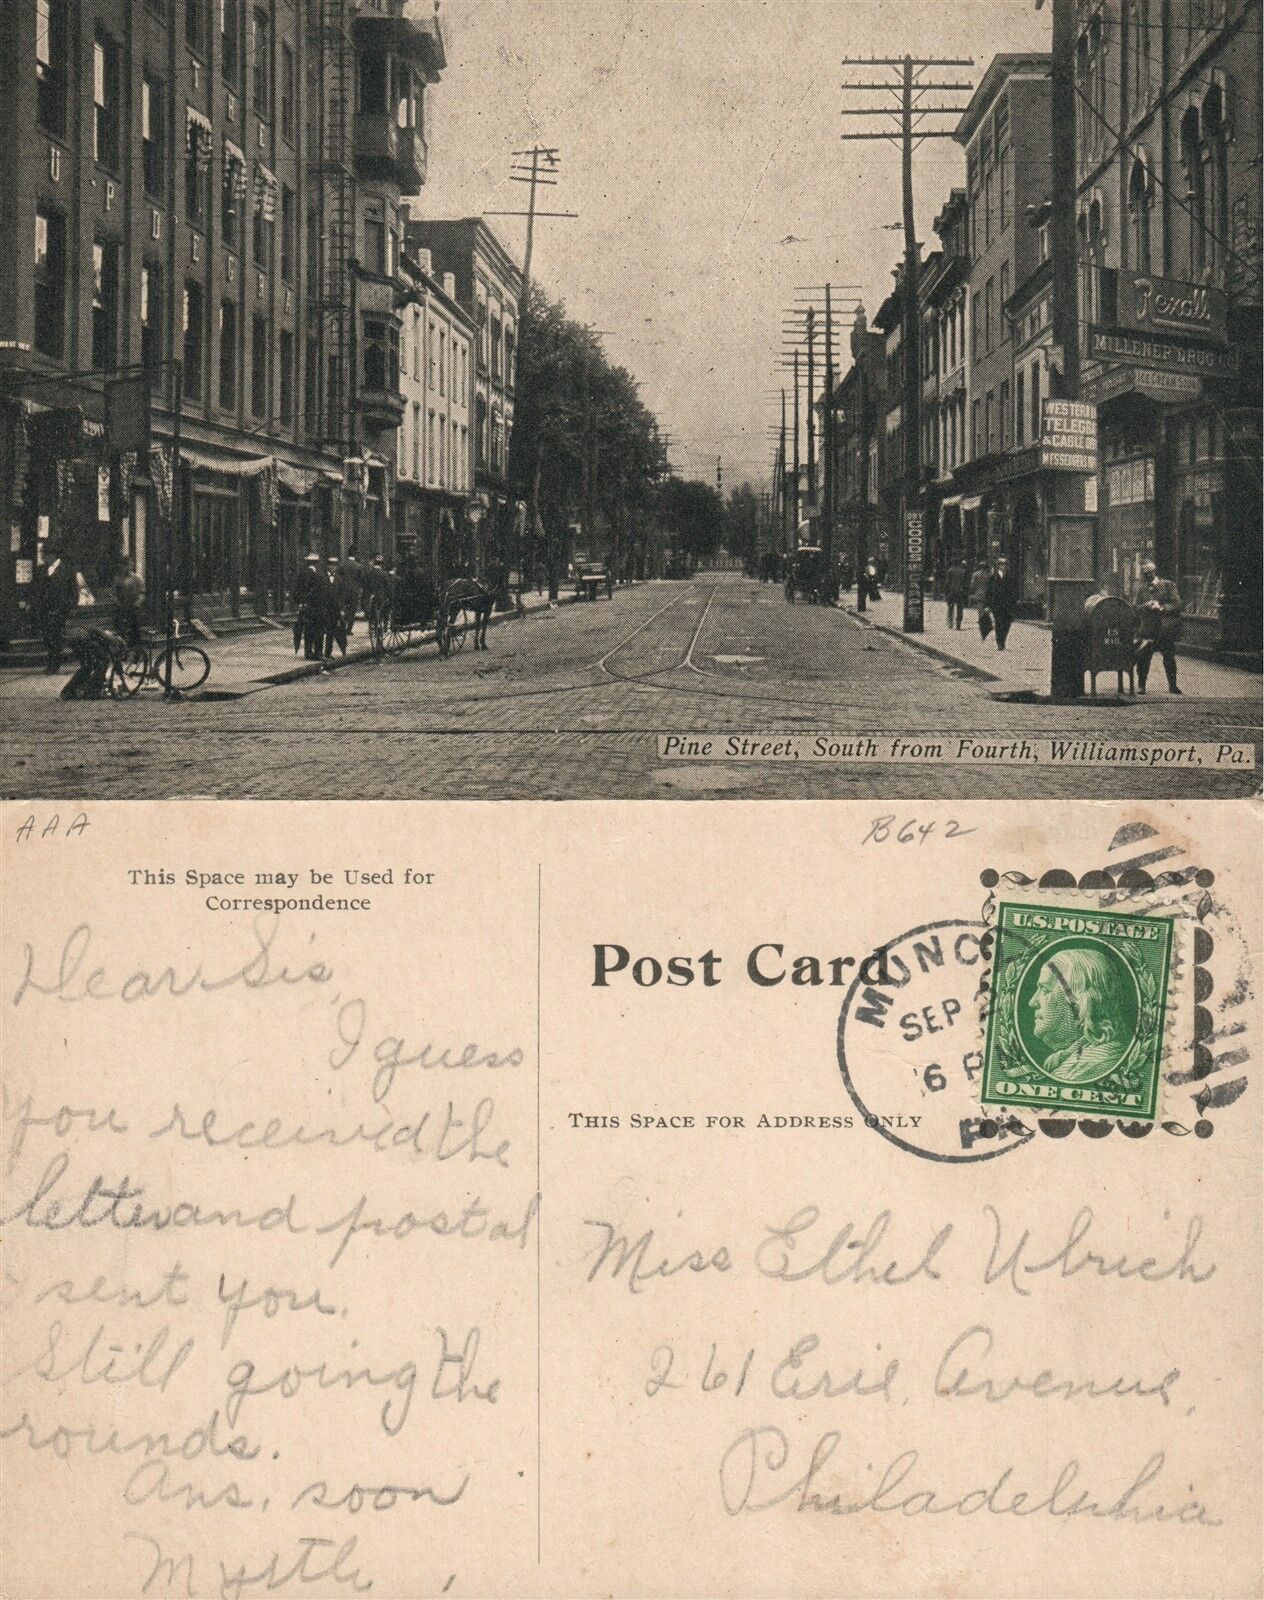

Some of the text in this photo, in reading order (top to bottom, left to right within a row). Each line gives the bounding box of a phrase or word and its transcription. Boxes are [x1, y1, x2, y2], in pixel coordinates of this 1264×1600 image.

[1134, 278, 1211, 320] Rexall
[1177, 347, 1215, 367] DRUG
[861, 813, 980, 846] B642
[127, 868, 436, 889] This Space may be Used for
[205, 895, 372, 914] Correspondence
[13, 923, 204, 1006] Dear
[591, 943, 891, 987] Post Card
[899, 998, 962, 1042] SEP
[372, 1036, 524, 1104] guess
[994, 1081, 1142, 1107] ONE CENT
[0, 1088, 129, 1178] you
[436, 1097, 511, 1169] the
[0, 1152, 543, 1268] letter and postal
[583, 1211, 733, 1295] Miss
[752, 1204, 954, 1286] Ethel
[35, 1259, 190, 1308] sent
[2, 1318, 195, 1394] Still
[225, 1342, 418, 1436] going
[291, 1472, 472, 1514] soon
[718, 1425, 1225, 1528] Philadelphia
